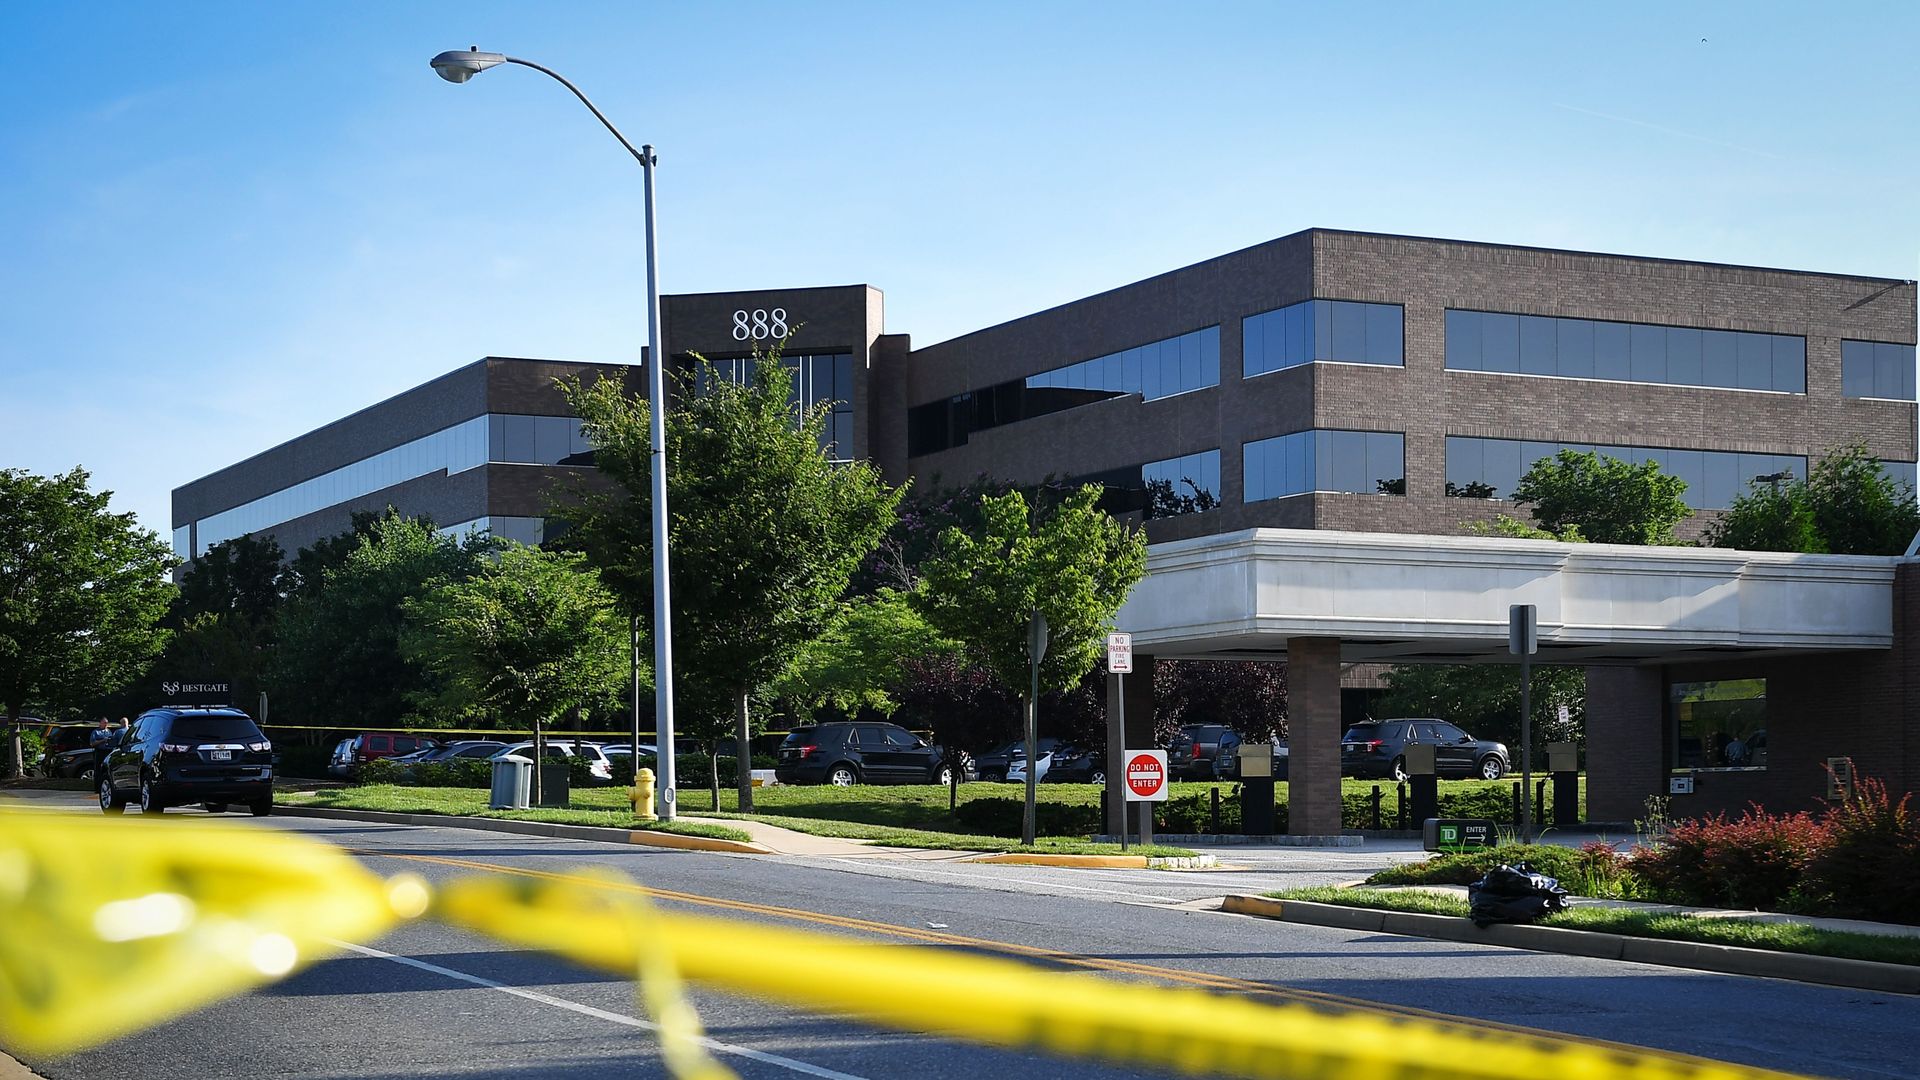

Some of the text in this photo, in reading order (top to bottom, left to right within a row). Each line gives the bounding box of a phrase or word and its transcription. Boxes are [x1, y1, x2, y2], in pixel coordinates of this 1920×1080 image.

[733, 308, 788, 340] 888
[1115, 636, 1125, 644] NO
[162, 681, 228, 696] 888 BESTGATE
[1133, 780, 1157, 788] ENTER
[1442, 828, 1456, 840] TD
